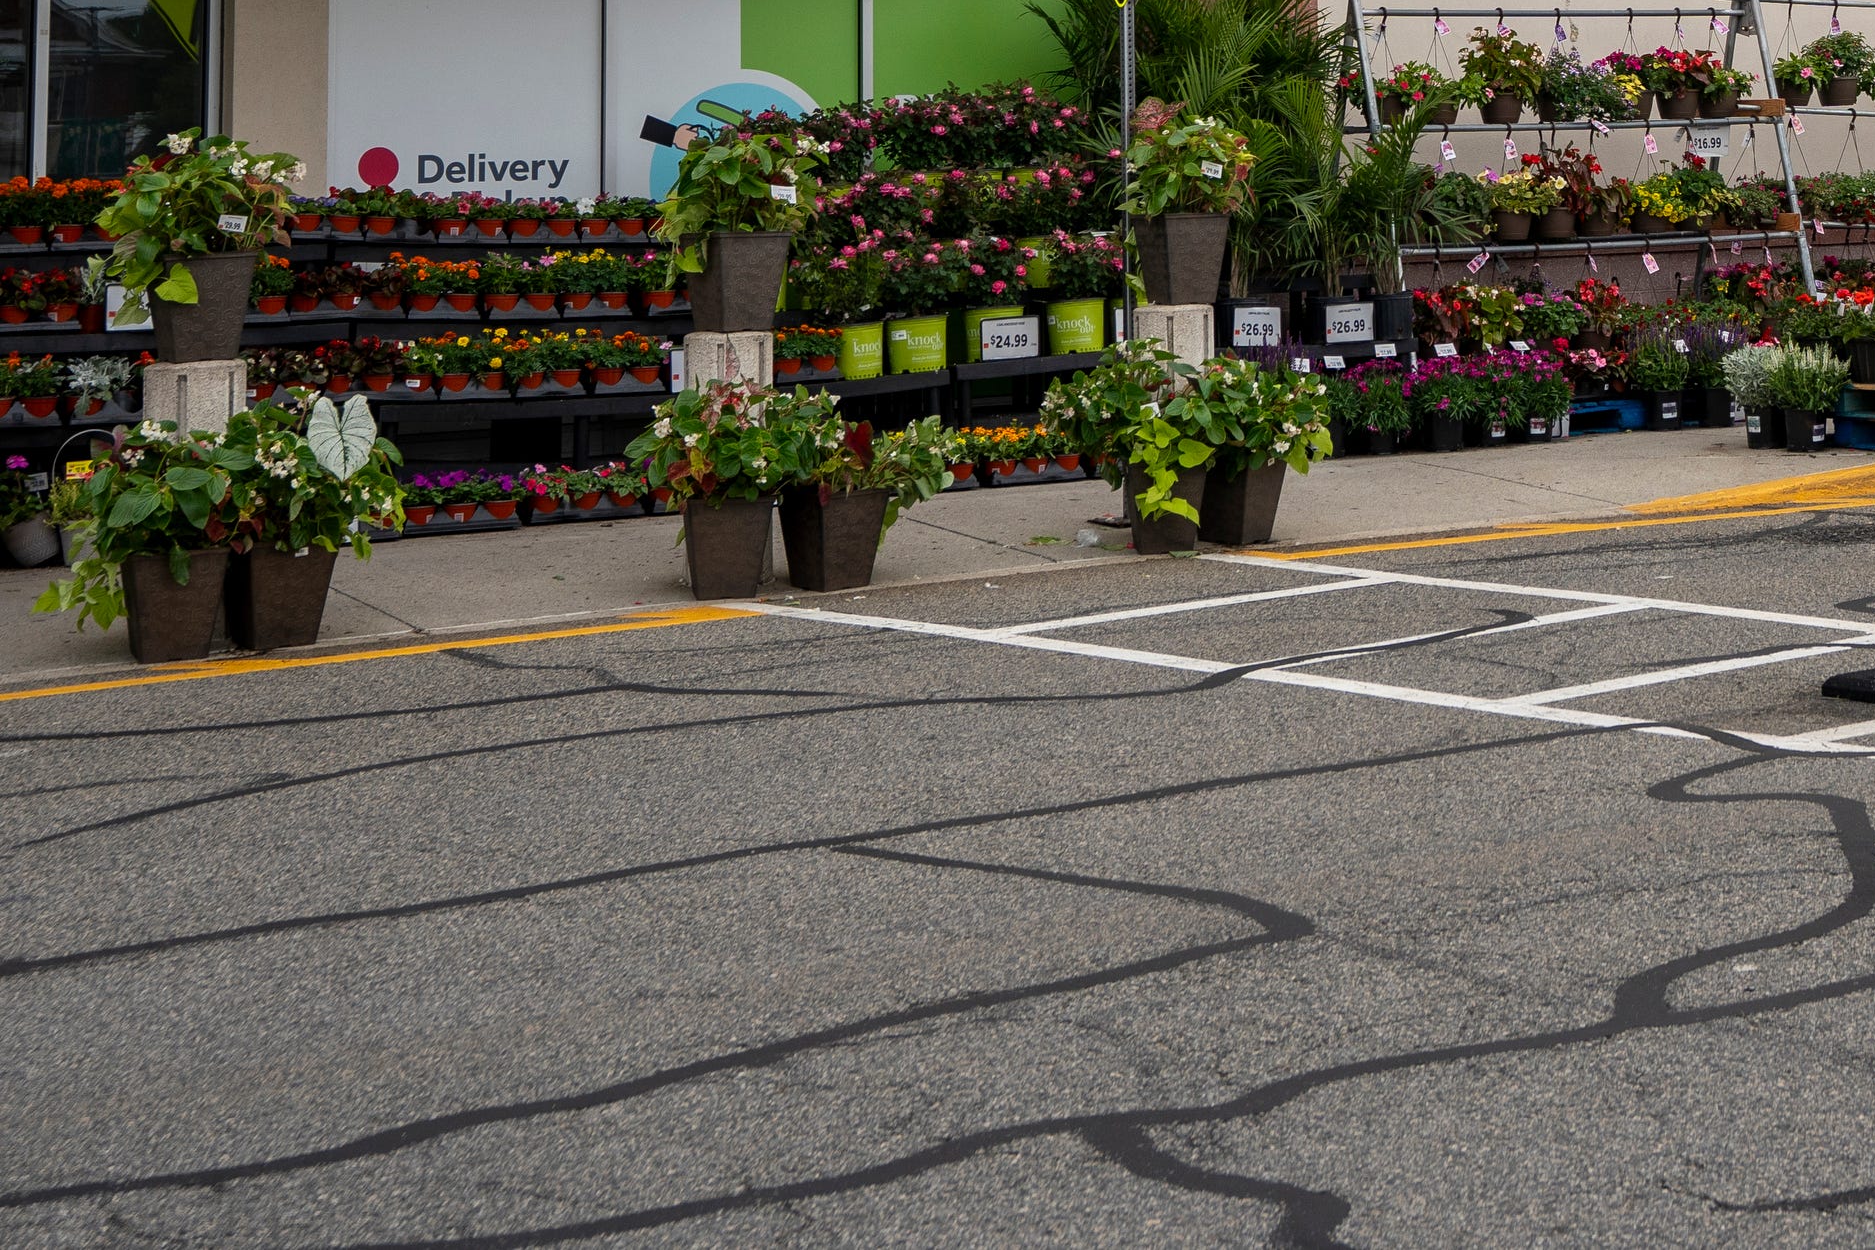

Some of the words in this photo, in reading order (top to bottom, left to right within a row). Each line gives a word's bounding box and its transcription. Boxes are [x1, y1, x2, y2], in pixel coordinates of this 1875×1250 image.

[1694, 137, 1722, 149] $16.99
[417, 153, 569, 188] Delivery
[1056, 315, 1090, 330] knock
[1241, 323, 1274, 336] $26.99
[1332, 319, 1365, 334] $26.99
[990, 333, 1028, 349] $24.99
